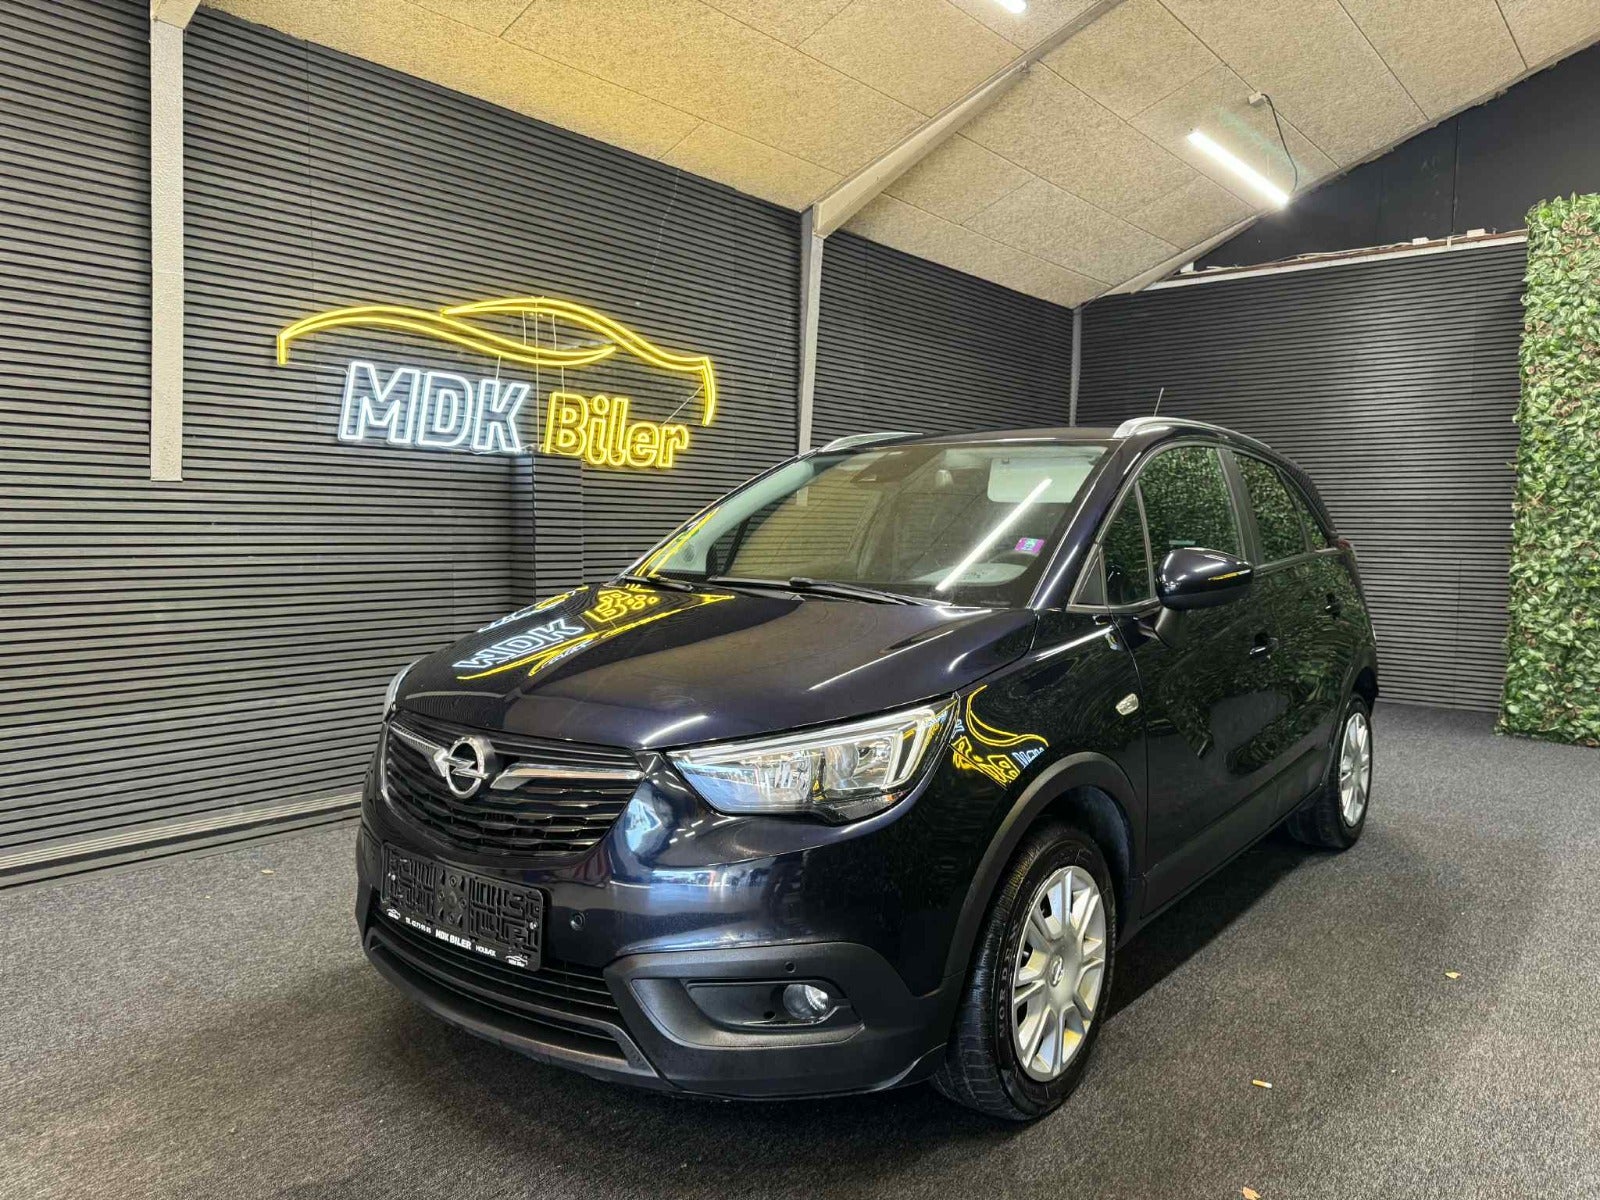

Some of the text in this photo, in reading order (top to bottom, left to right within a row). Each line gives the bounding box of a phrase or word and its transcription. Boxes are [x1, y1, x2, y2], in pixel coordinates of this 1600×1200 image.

[337, 361, 689, 469] MDK Biler
[435, 929, 449, 942] MDK
[449, 934, 472, 950] BILER
